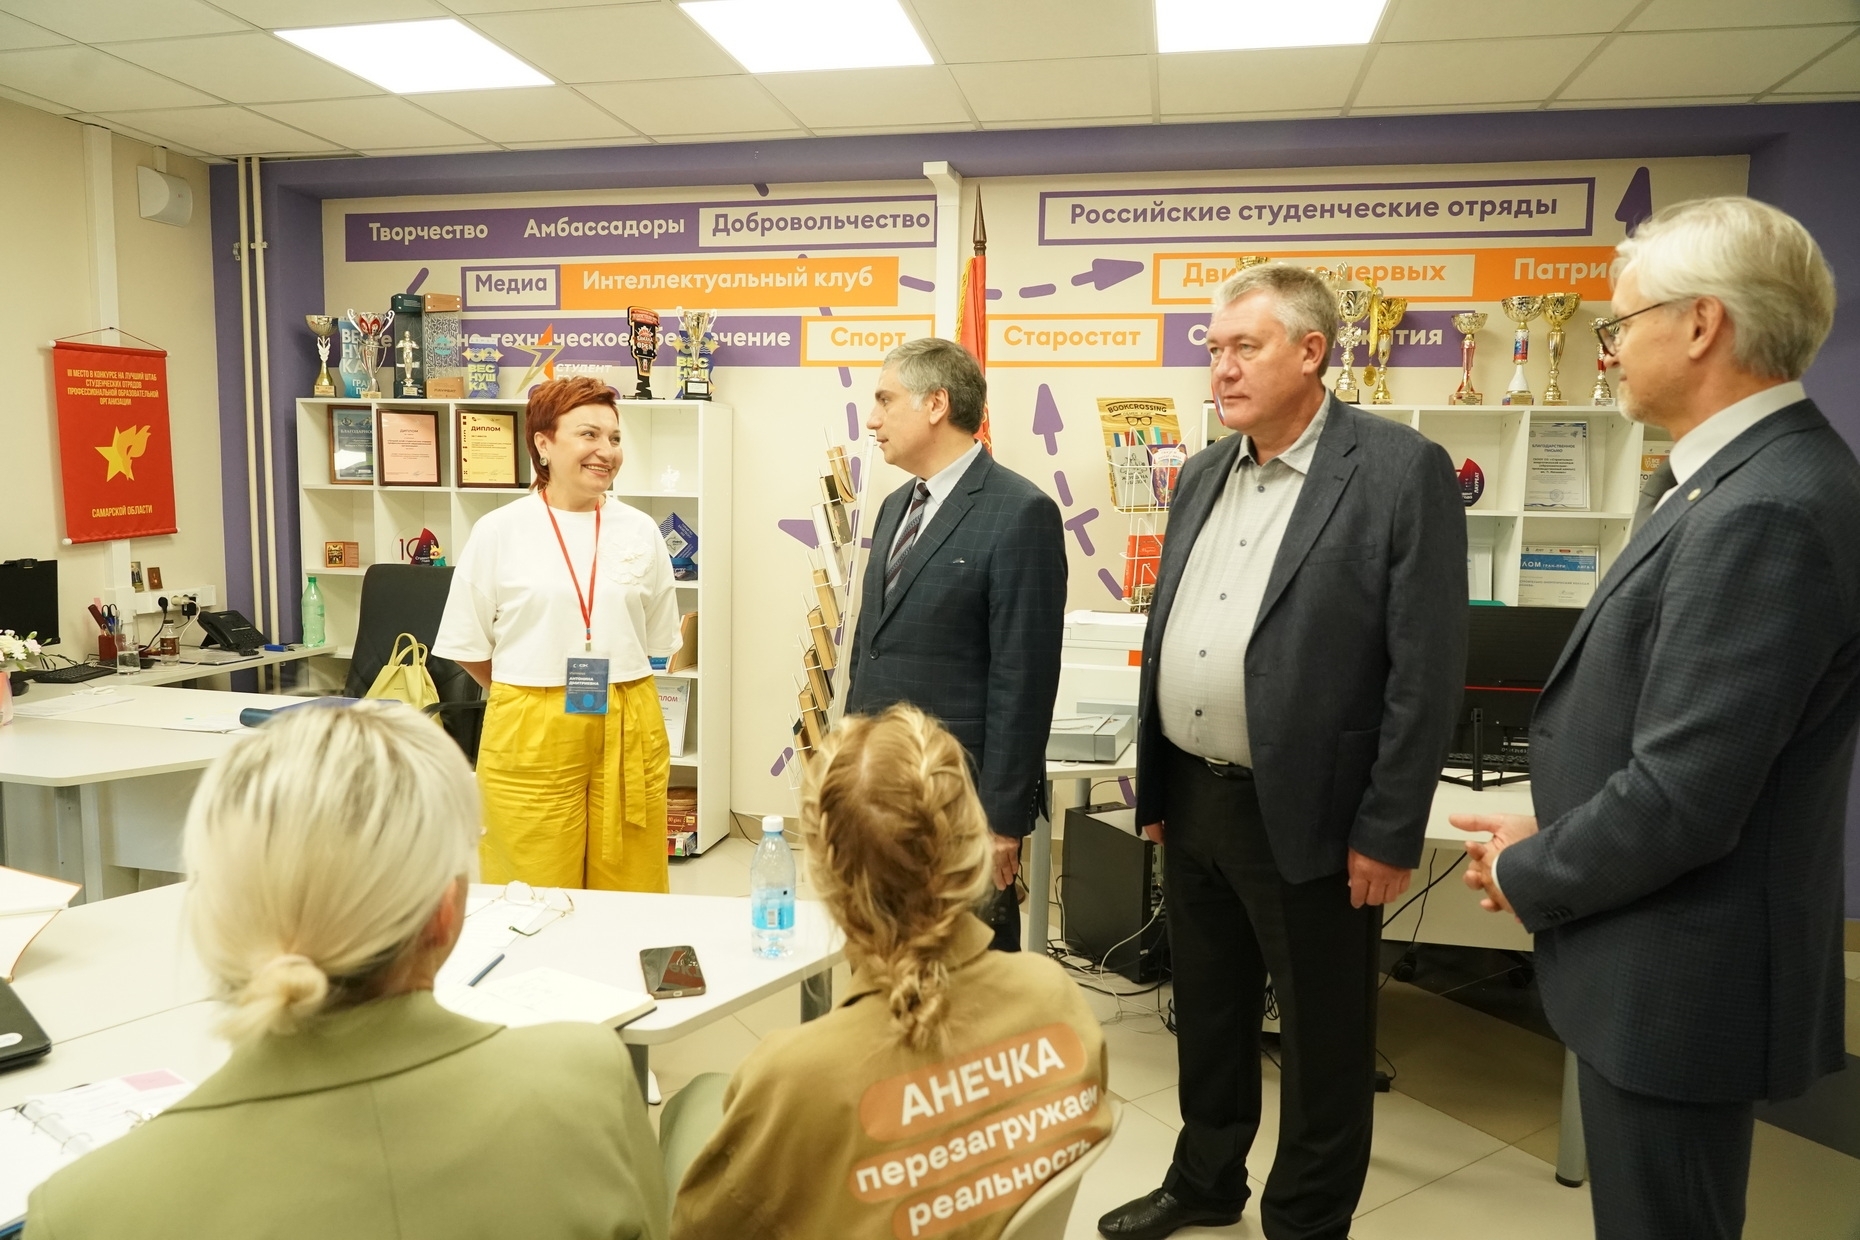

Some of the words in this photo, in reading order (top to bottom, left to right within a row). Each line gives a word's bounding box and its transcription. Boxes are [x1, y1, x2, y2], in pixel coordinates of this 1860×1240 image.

[1070, 200, 1231, 225] Российские
[1238, 199, 1440, 226] студенческие
[1447, 198, 1558, 222] отряды
[368, 222, 489, 245] Творчество
[523, 216, 685, 239] Амбассадоры
[712, 211, 931, 237] Добровольчество
[475, 273, 548, 294] Медиа
[582, 267, 808, 294] Интеллектуальный
[814, 265, 873, 290] клуб
[830, 326, 906, 351] Спорт
[1003, 324, 1141, 351] Старостат
[467, 363, 496, 373] ВЕС
[555, 363, 613, 374] СТУДЕНТ
[73, 369, 90, 378] МЕСТО
[94, 370, 117, 379] КОНКУРСЕ
[118, 371, 124, 379] НА
[125, 372, 144, 380] ЛУЧШИЙ
[145, 373, 157, 381] ШТАБ
[468, 373, 497, 382] НУШ
[86, 379, 121, 388] СТУДЕНЧЕСКИХ
[122, 380, 142, 389] ОТРЯДОВ
[468, 381, 489, 391] КА
[67, 387, 118, 397] ПРОФЕССИОНАЛЬНОЙ
[118, 389, 159, 398] ОБРАЗОВАТЕЛЬНОЙ
[100, 397, 131, 406] ОРГАНИЗАЦИИ
[1107, 403, 1167, 413] BOOKCROSSING
[92, 505, 127, 518] САМАРСКОЙ
[127, 504, 153, 515] ОБЛАСТИ
[901, 1036, 1066, 1127] АНЕЧКА
